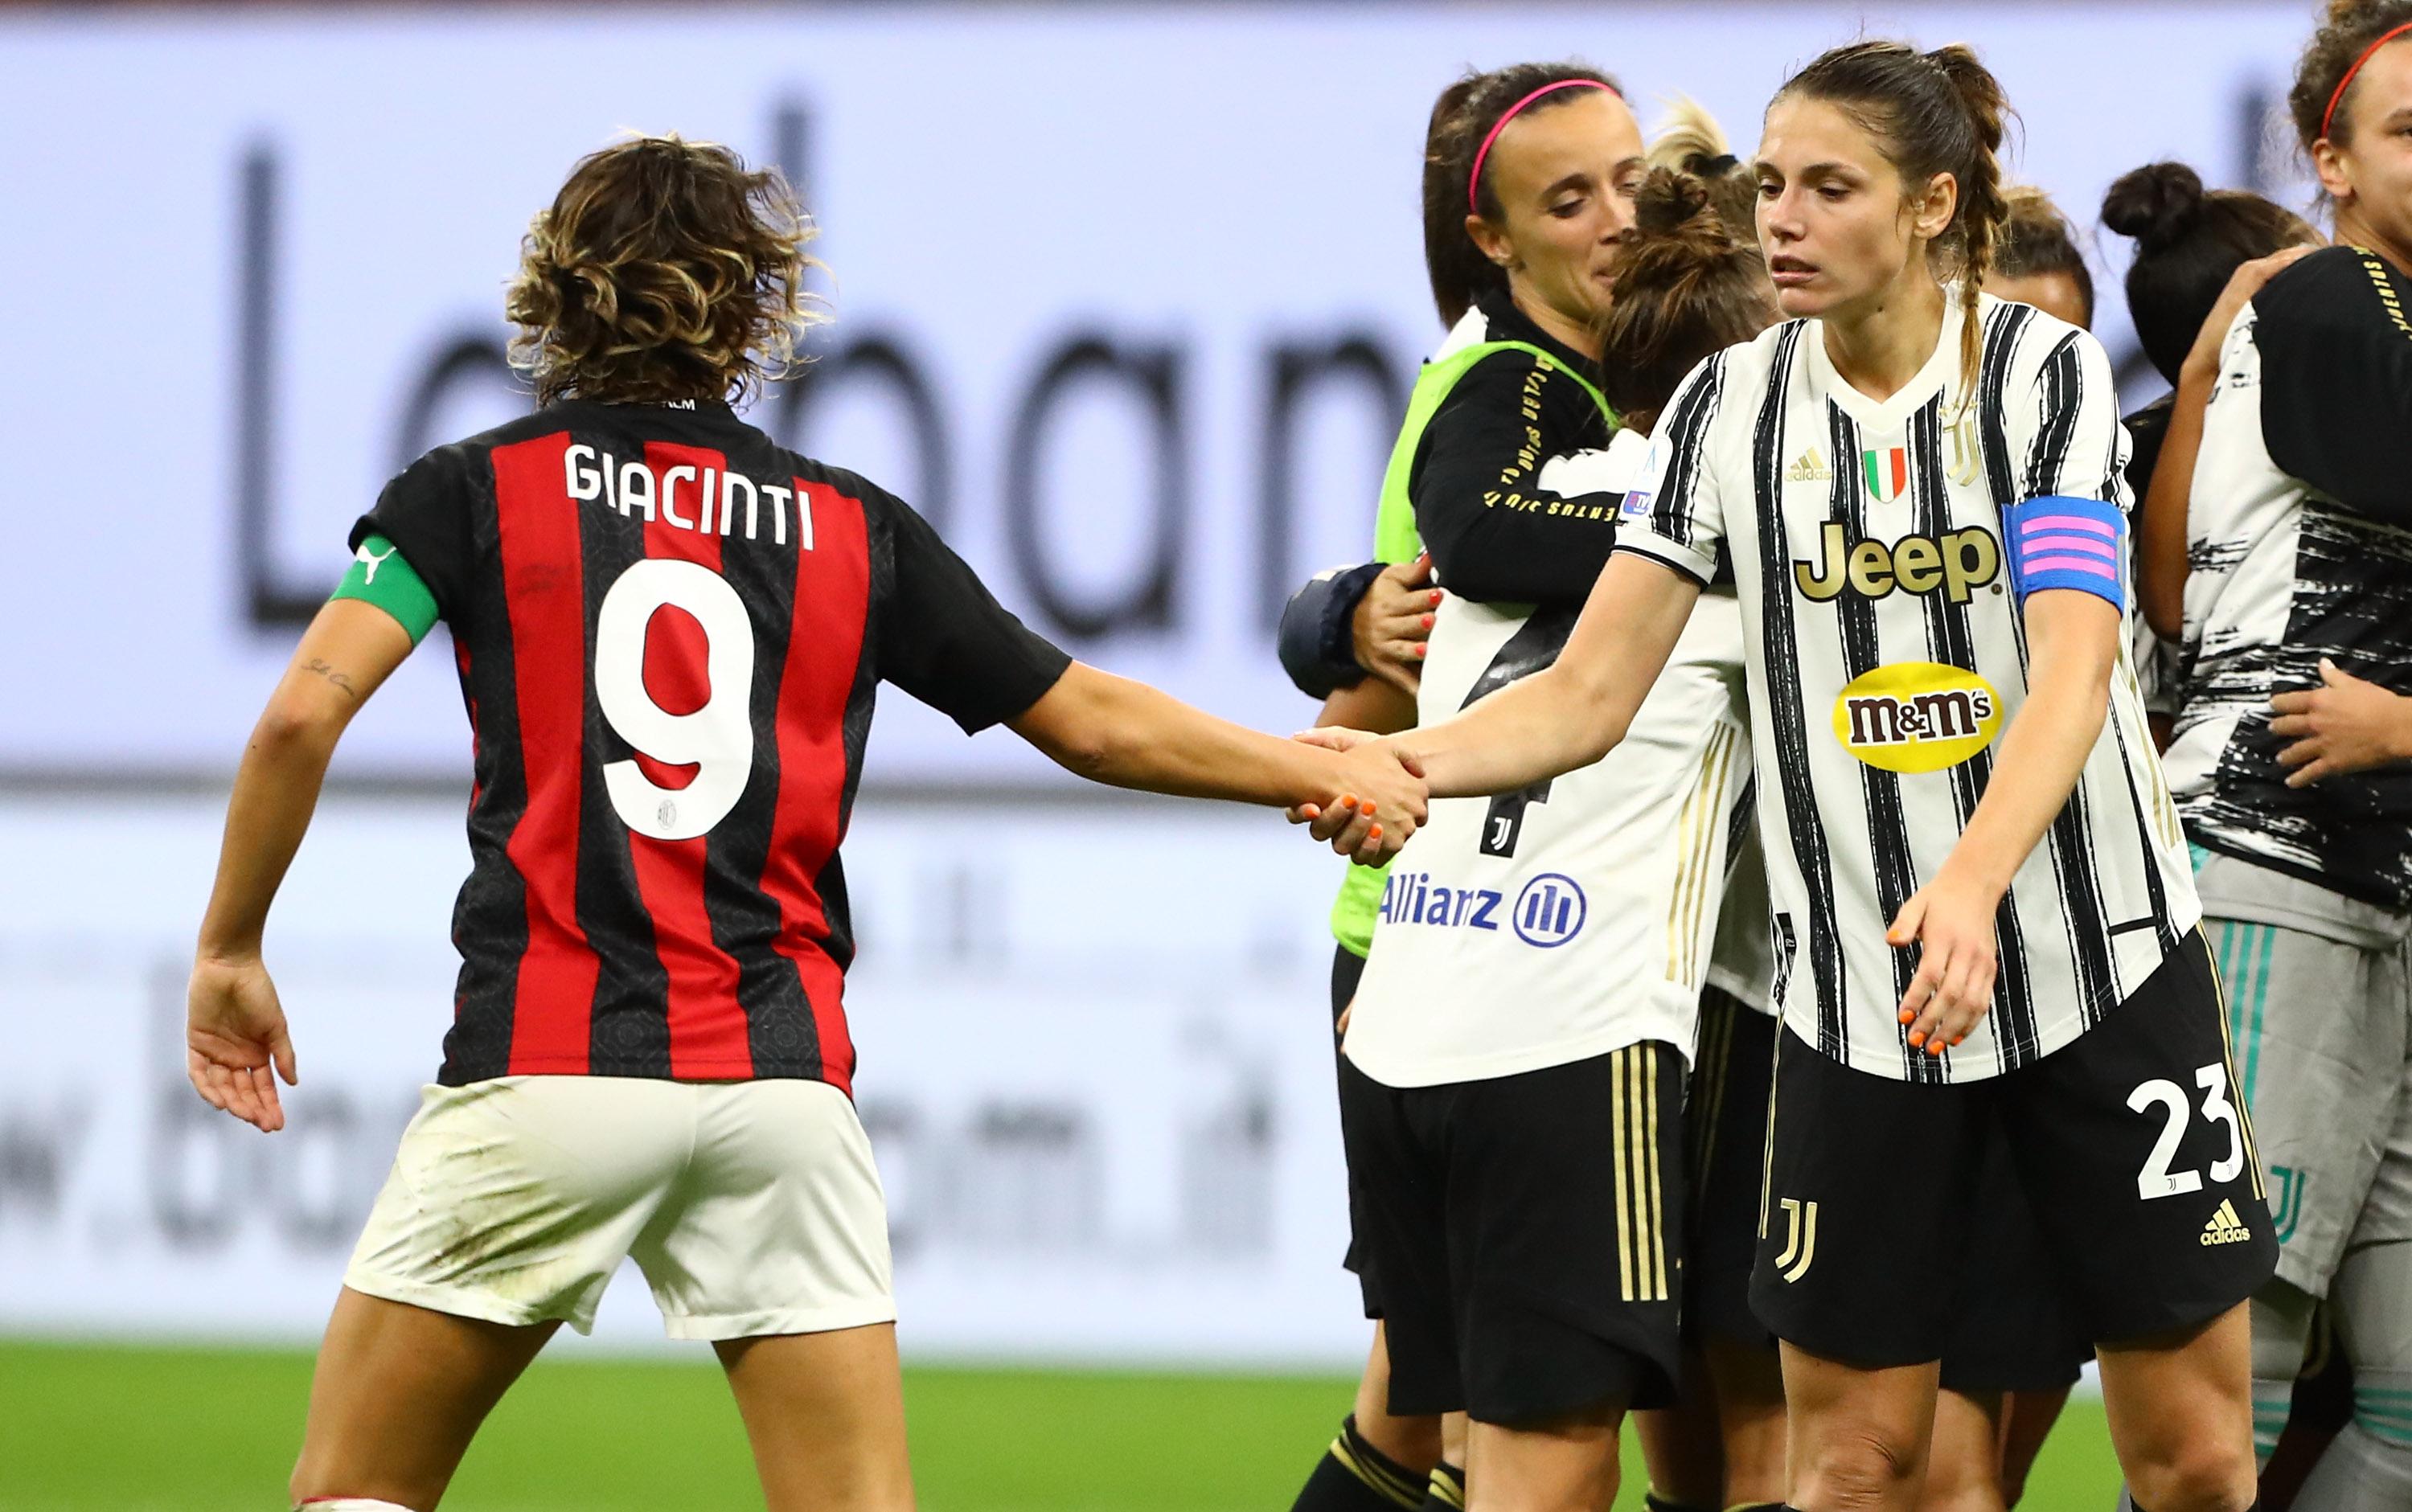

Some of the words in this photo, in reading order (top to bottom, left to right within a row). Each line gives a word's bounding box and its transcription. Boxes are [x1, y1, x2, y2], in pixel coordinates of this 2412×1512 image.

[564, 444, 814, 551] GIACINTI
[1794, 522, 2000, 604] Jeep
[594, 559, 755, 841] 9
[1379, 873, 1503, 931] Allianz
[2126, 1062, 2244, 1200] 23
[2200, 1226, 2251, 1246] adidas
